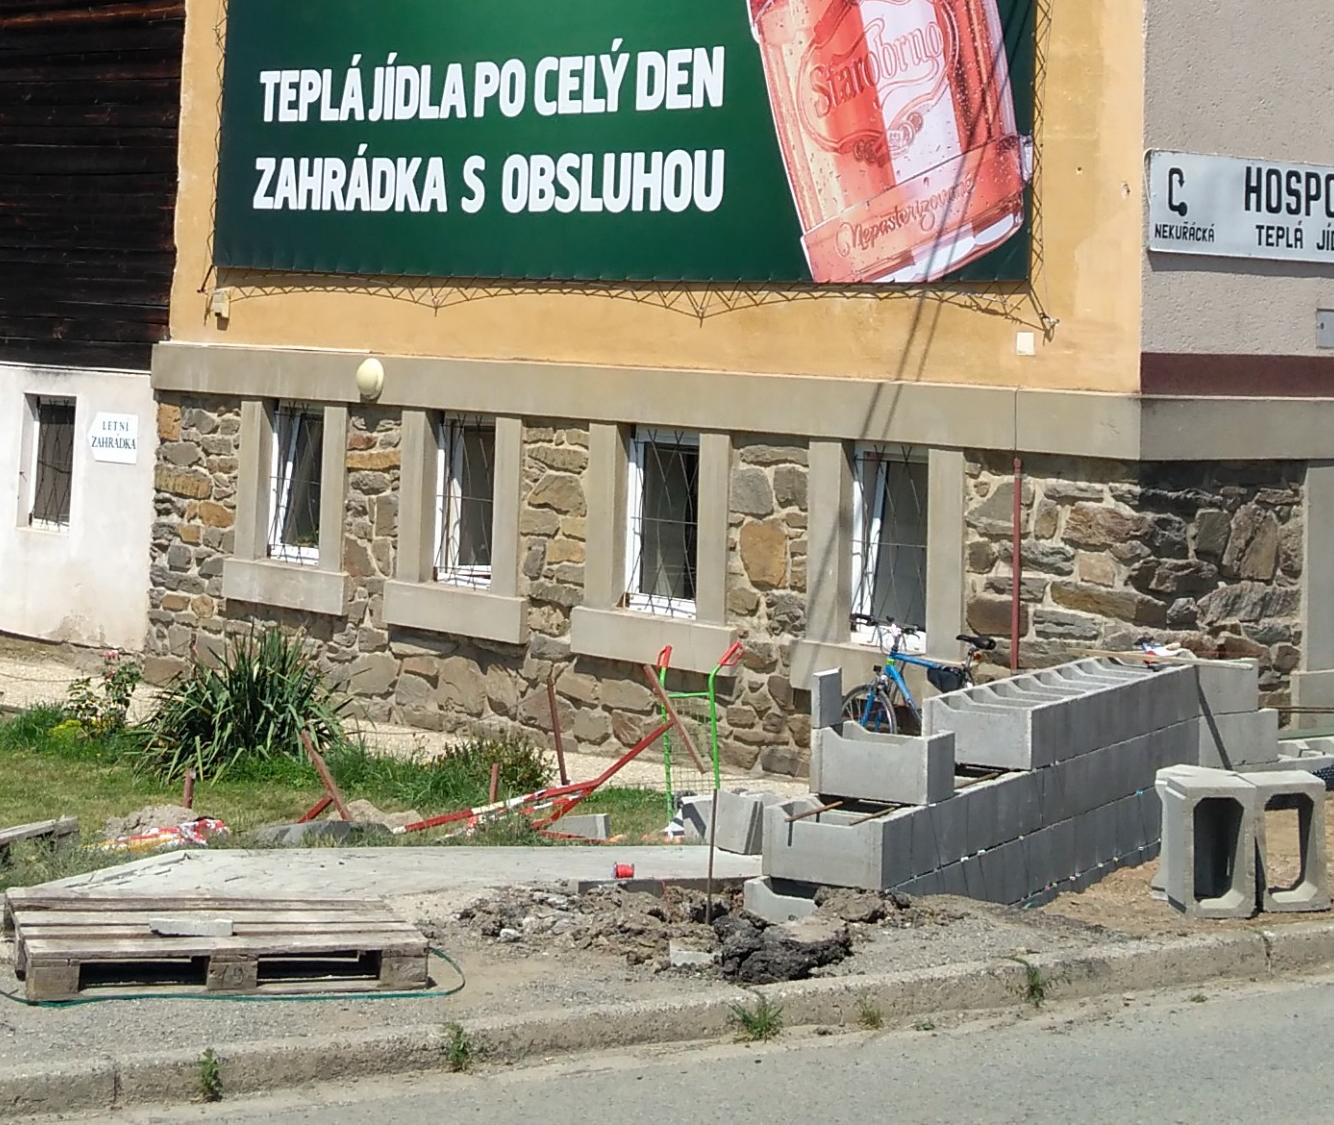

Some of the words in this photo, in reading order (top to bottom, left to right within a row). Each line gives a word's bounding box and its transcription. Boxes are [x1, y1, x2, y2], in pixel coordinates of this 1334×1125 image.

[260, 53, 364, 122] TEPLÁ
[368, 52, 467, 122] JÍDLA
[474, 59, 527, 117] PO
[534, 38, 630, 117] CELÝ
[636, 46, 725, 112] DEN
[809, 18, 943, 117] Starobrno
[253, 143, 448, 213] ZAHRÁDKA
[461, 155, 486, 213] S
[502, 149, 725, 213] OBSLUHOU
[1155, 221, 1215, 243] NEKUŘÁCKÁ
[1256, 220, 1304, 249] TEPLÁ
